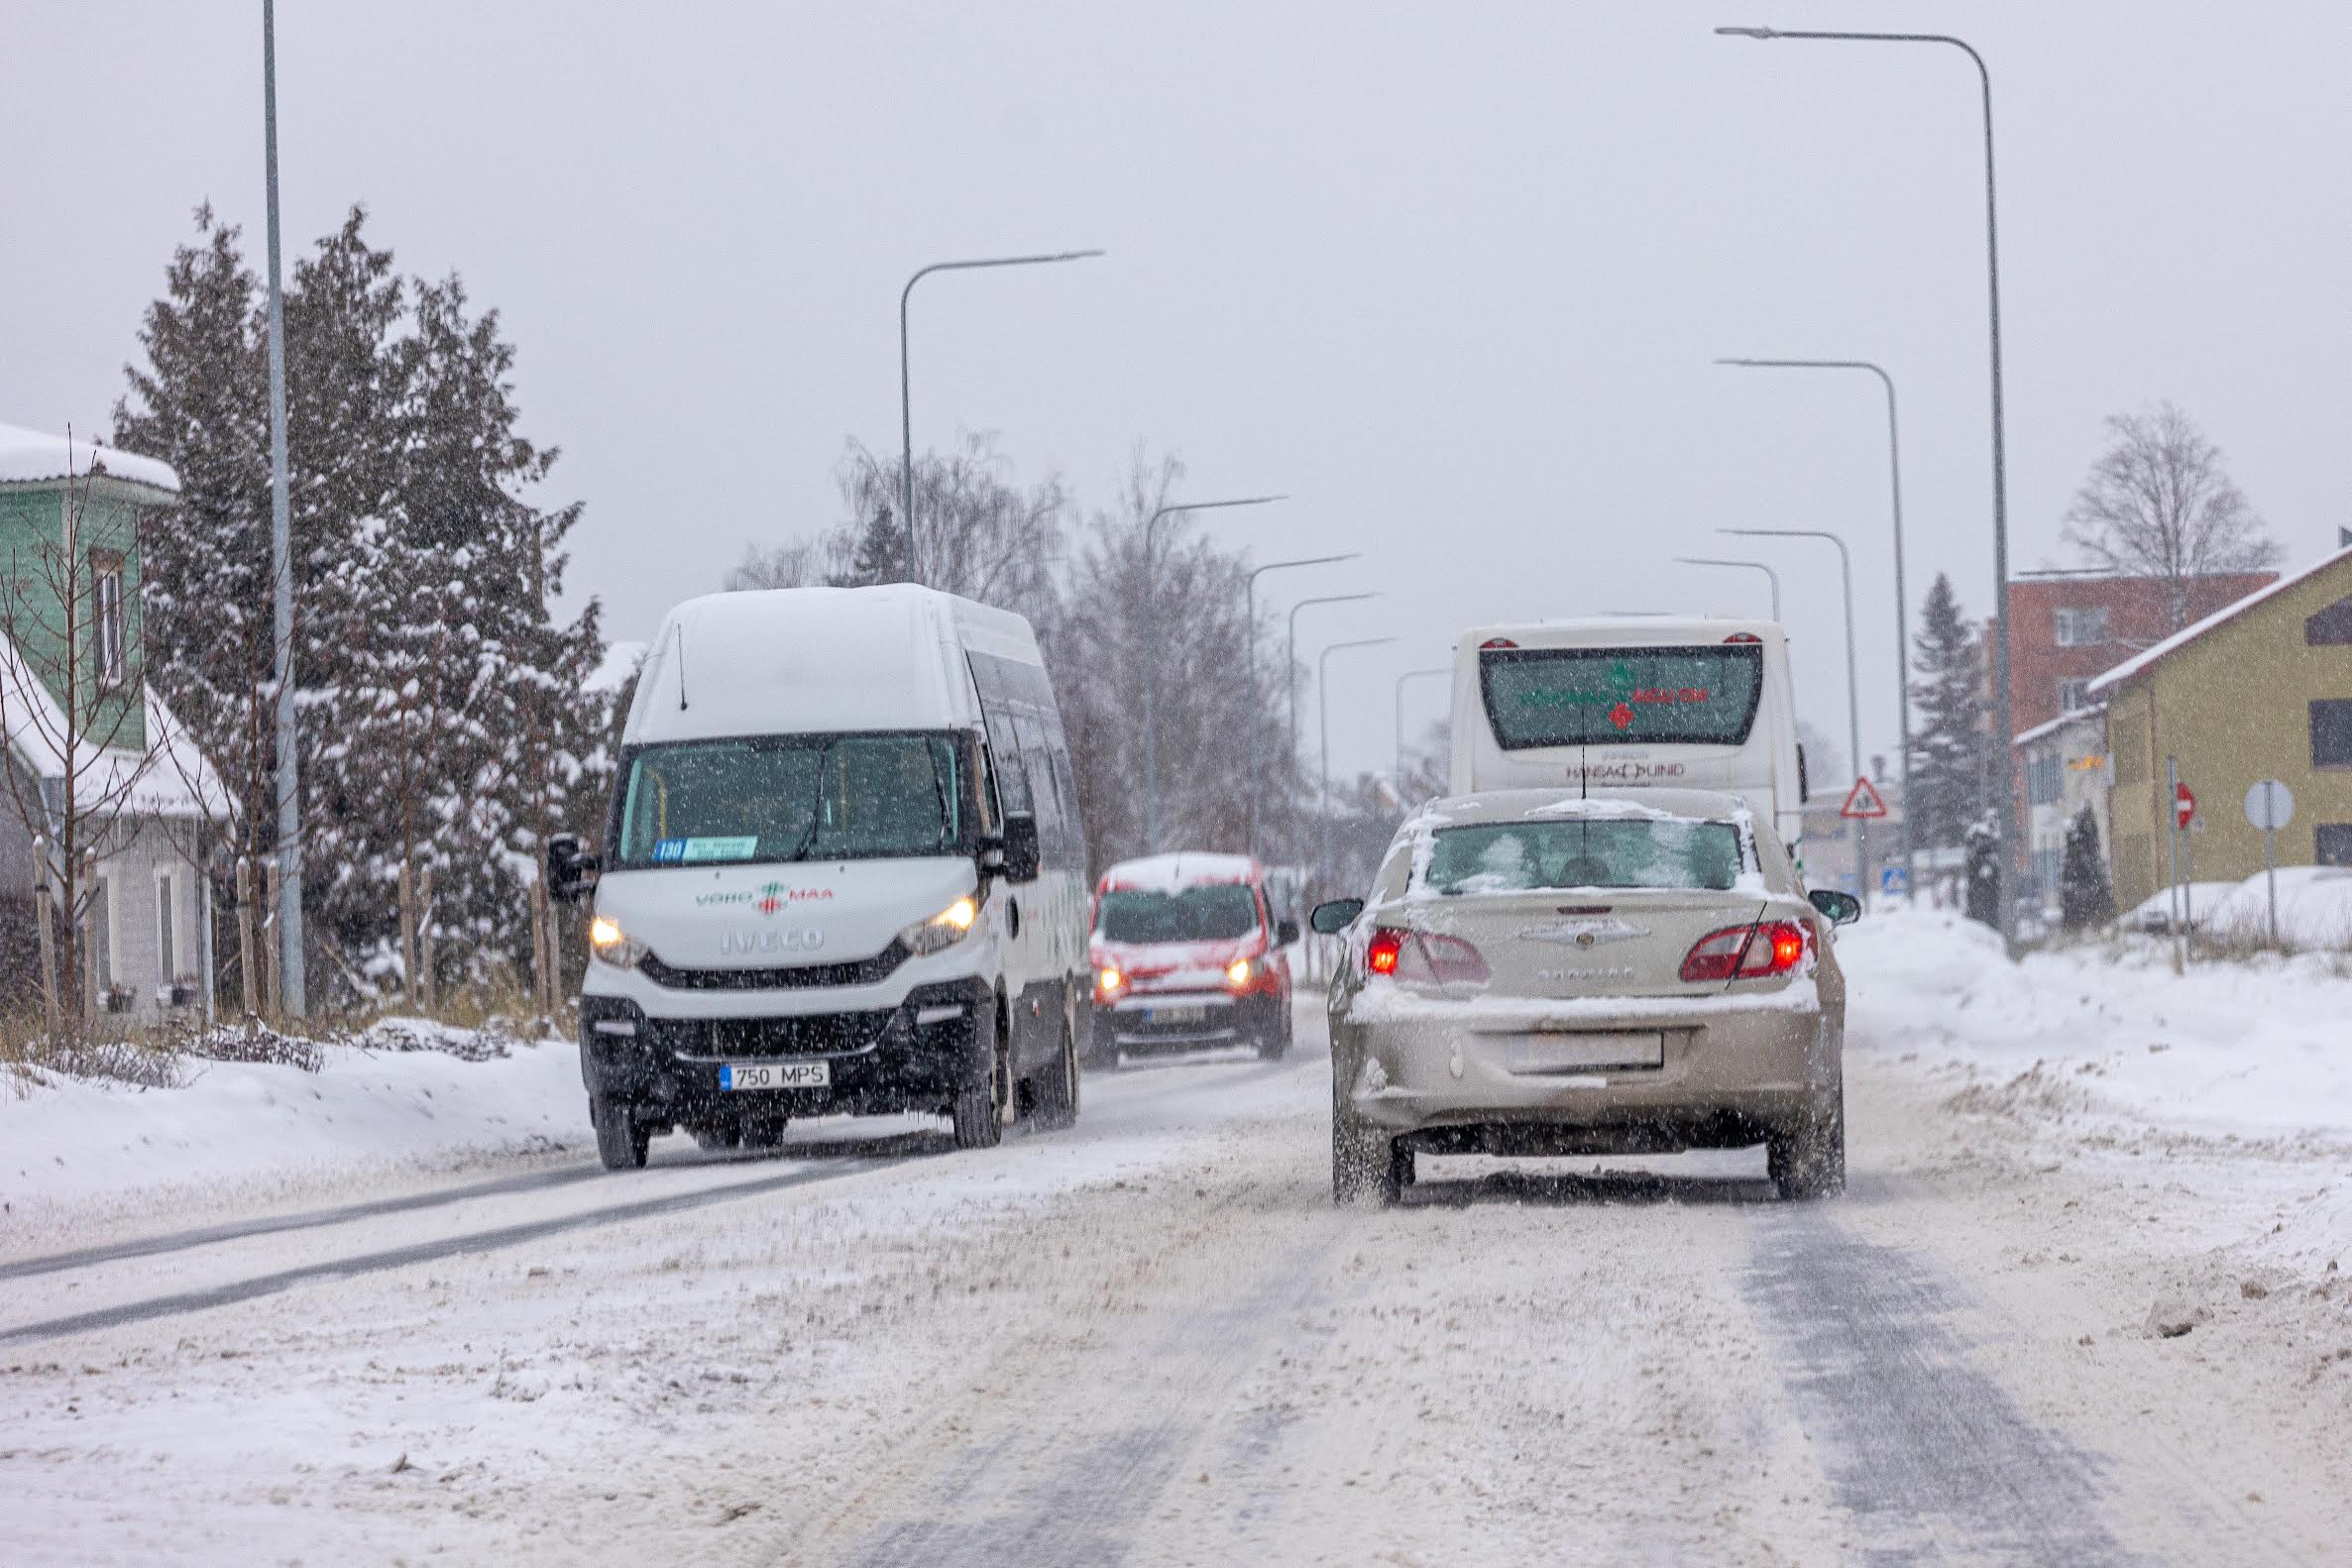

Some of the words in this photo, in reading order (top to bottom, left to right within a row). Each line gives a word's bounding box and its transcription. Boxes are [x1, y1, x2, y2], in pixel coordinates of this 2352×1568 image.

[789, 887, 834, 901] MAA
[720, 929, 825, 954] IVECO
[736, 1067, 770, 1087] 750
[781, 1065, 825, 1084] MPS
